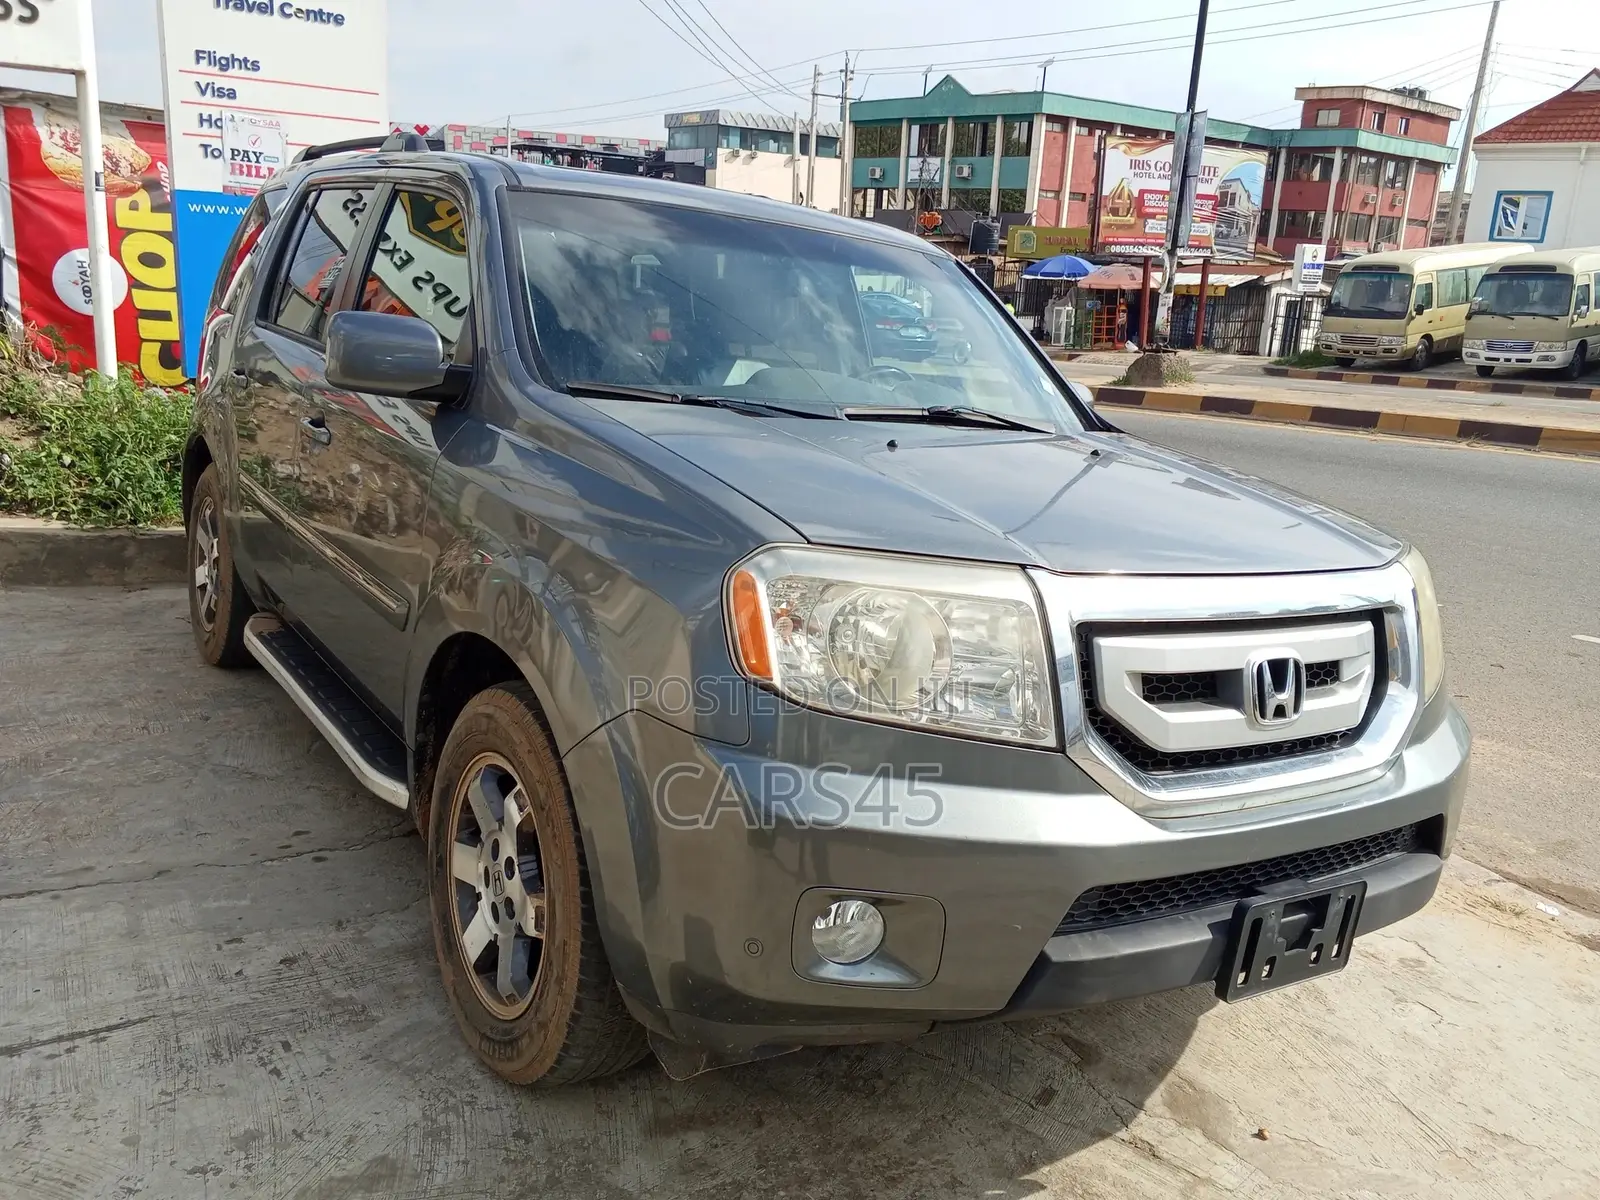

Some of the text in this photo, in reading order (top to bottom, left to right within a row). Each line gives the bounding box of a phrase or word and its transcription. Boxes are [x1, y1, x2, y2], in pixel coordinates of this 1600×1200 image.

[212, 0, 345, 26] Travel Centre
[194, 49, 261, 72] Flights
[195, 81, 237, 100] Visa
[198, 113, 223, 129] Ho
[200, 144, 222, 160] To
[229, 148, 264, 164] PAY
[1129, 159, 1152, 171] IRIS
[1154, 160, 1172, 173] GO
[1133, 171, 1156, 179] HOTEL
[76, 260, 93, 305] SOOYAH
